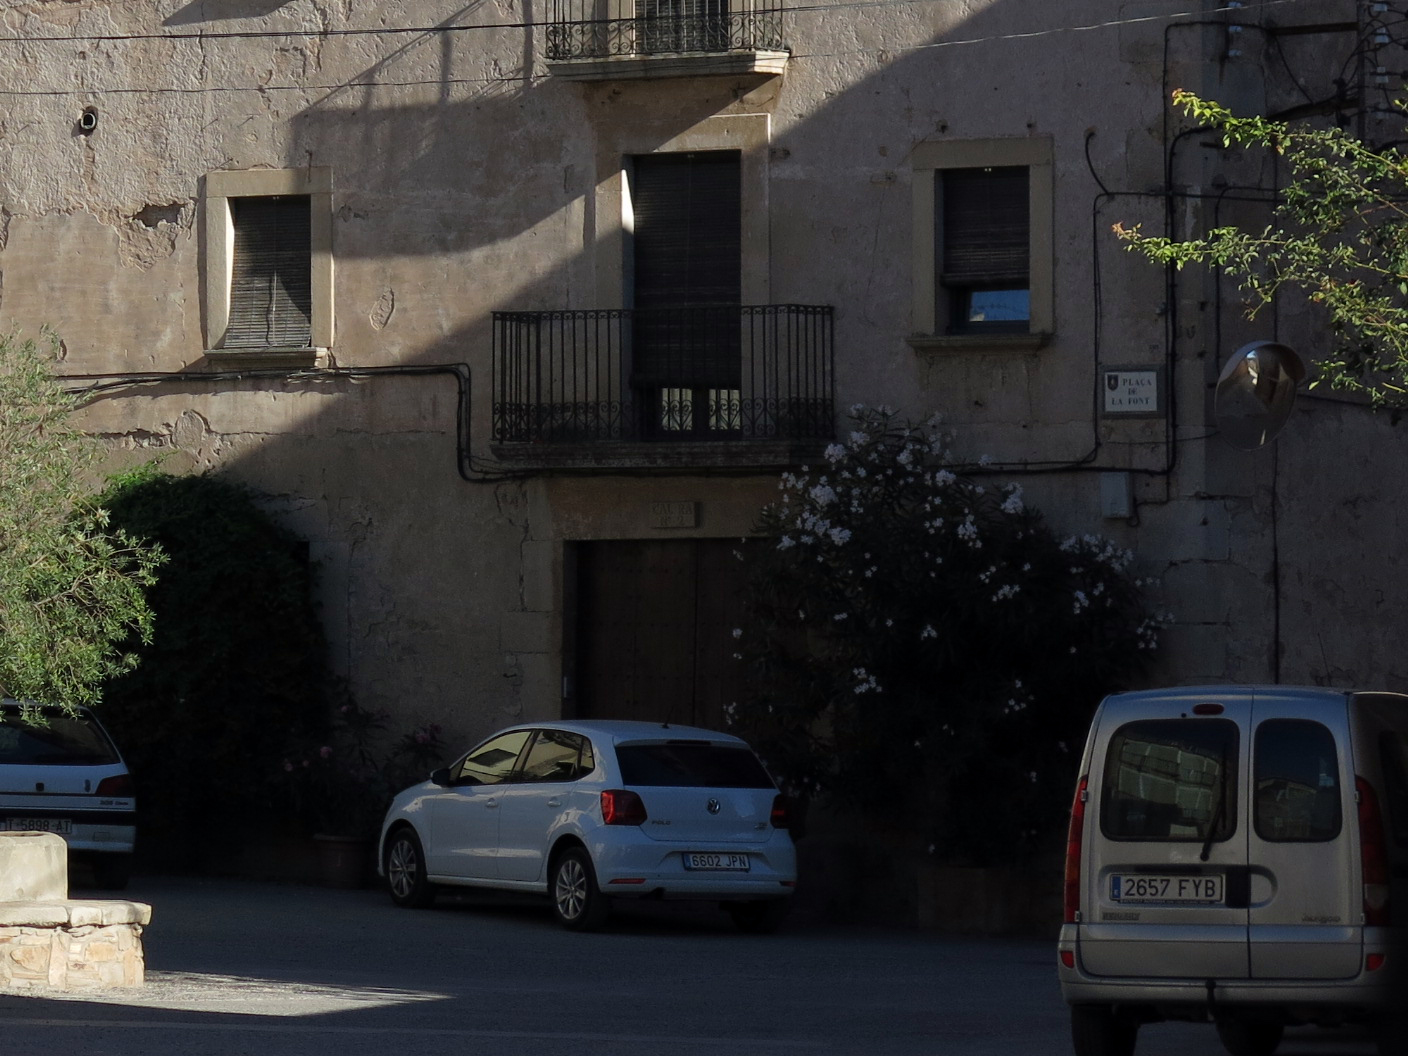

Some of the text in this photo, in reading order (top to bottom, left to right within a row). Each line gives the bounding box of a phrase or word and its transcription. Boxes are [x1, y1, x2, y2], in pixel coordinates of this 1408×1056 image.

[1123, 378, 1152, 387] PLAÇA
[1128, 387, 1137, 395] DE
[692, 855, 747, 867] 6602 JPN
[1124, 879, 1216, 897] 2657 FYB
